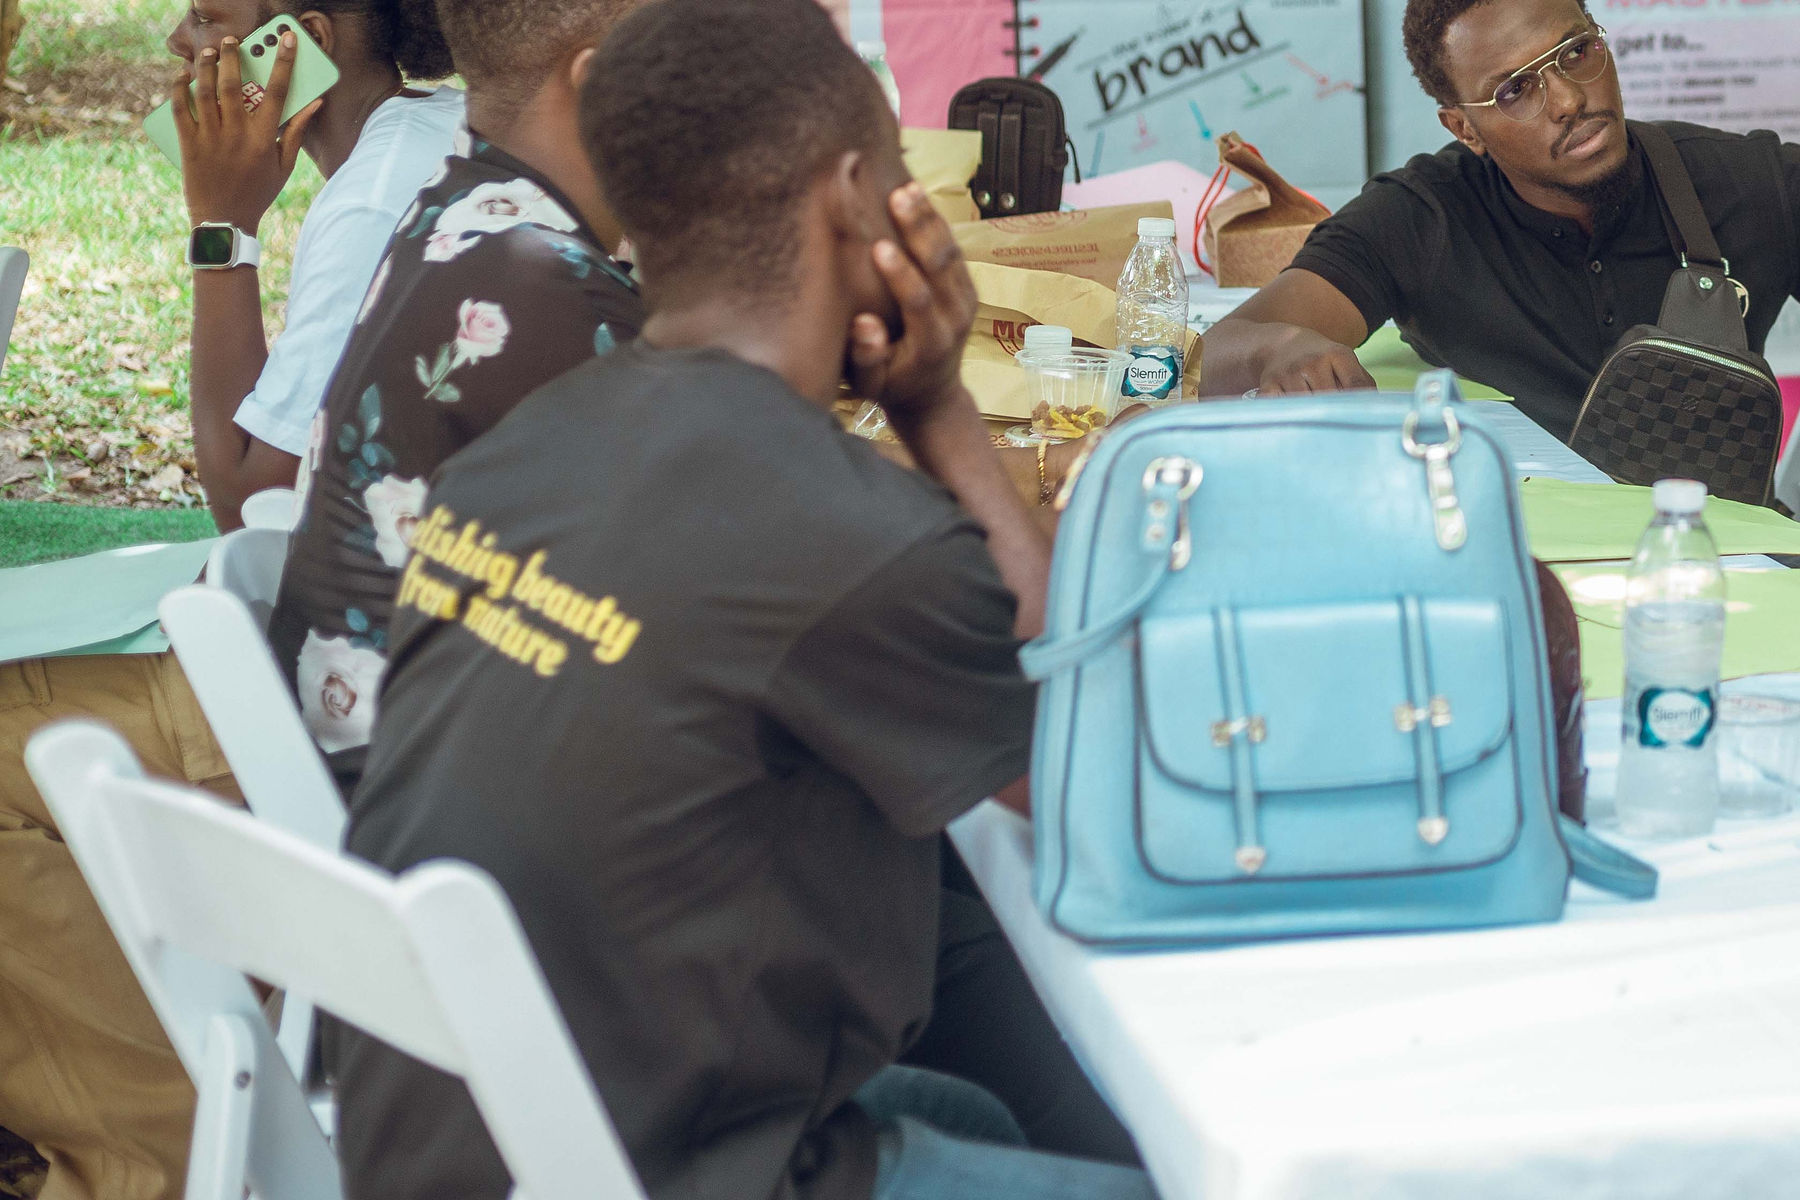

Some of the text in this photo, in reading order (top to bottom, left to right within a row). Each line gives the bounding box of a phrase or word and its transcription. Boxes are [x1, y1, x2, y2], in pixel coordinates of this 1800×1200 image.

[1092, 6, 1261, 113] brand
[1615, 34, 1655, 57] get
[1130, 367, 1168, 379] Slemfit
[463, 596, 569, 677] nature
[512, 550, 642, 666] beauty
